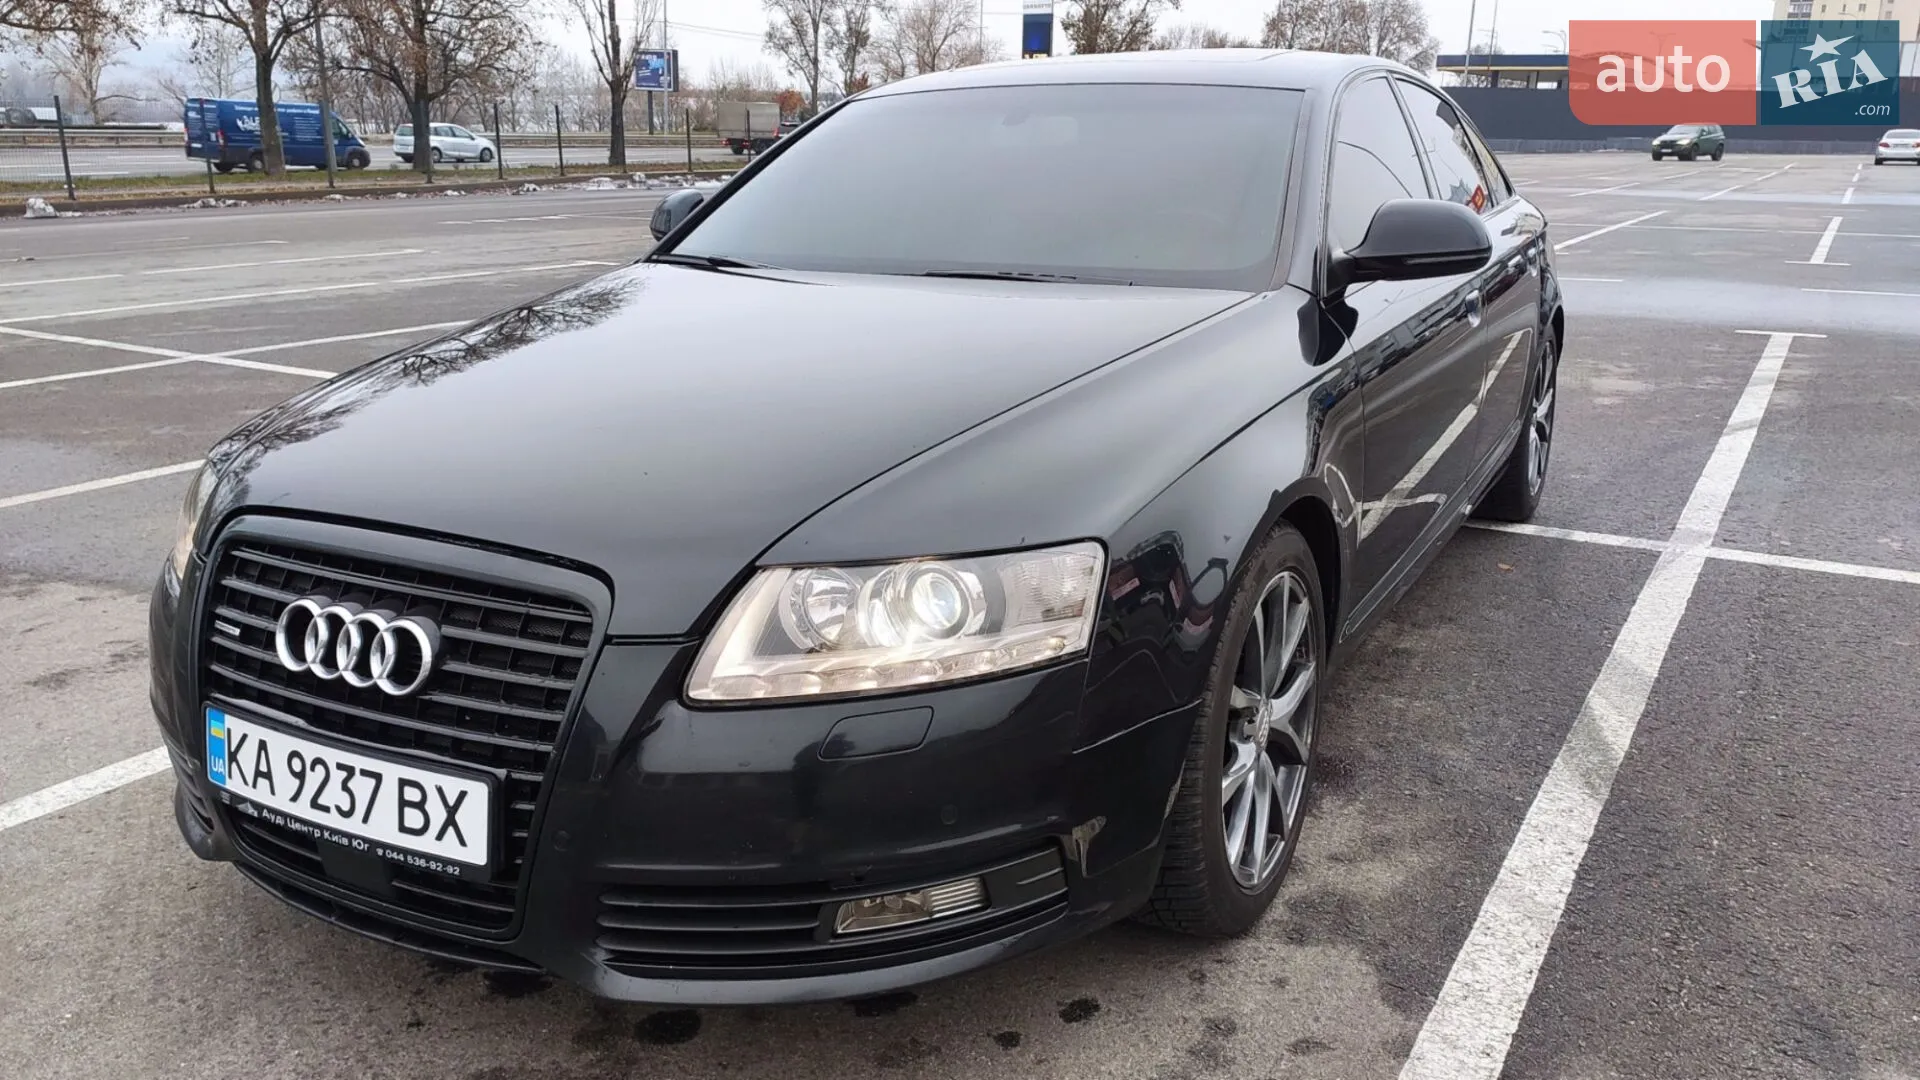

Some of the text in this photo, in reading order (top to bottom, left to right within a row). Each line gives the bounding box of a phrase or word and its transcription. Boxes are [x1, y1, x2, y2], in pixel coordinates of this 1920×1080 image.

[211, 755, 225, 776] UA
[227, 727, 468, 848] KA 9237 BX
[286, 816, 321, 839] Центр
[323, 830, 349, 847] Київ
[352, 839, 370, 851] Юг
[386, 849, 404, 861] 044
